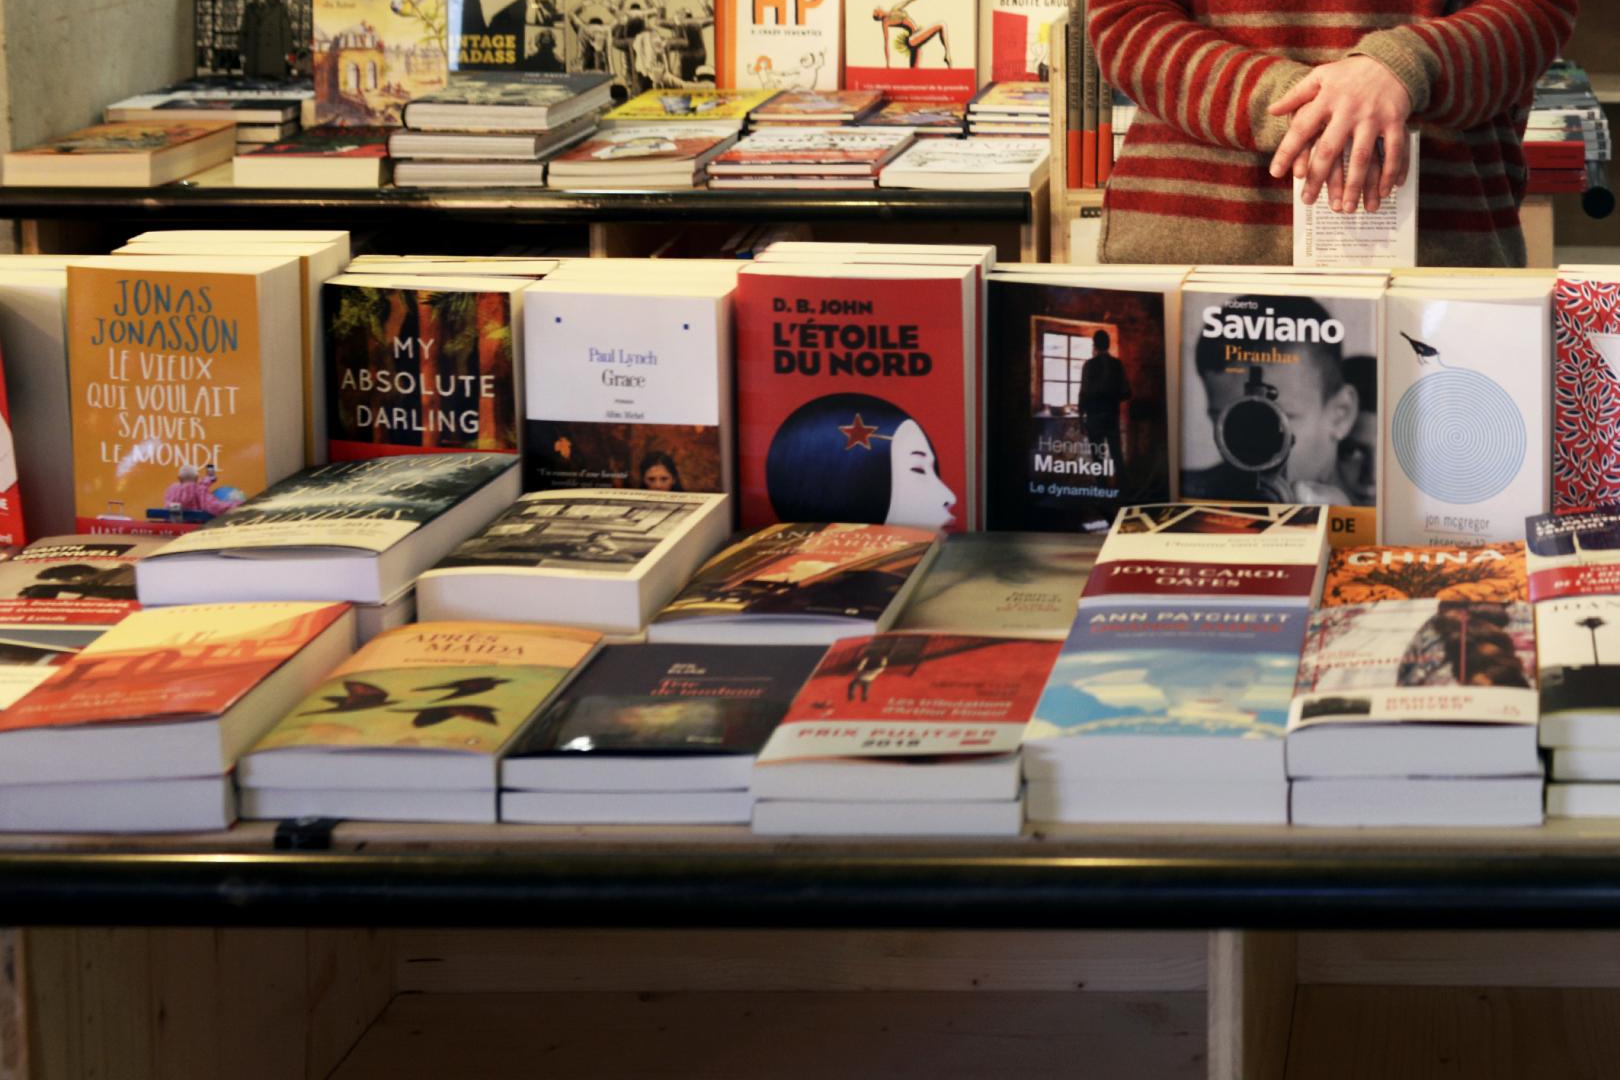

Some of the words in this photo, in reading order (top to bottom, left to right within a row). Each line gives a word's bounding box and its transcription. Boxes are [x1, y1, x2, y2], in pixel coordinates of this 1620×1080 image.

[459, 33, 516, 49] NTAGE
[458, 49, 516, 64] ADASS
[113, 279, 214, 317] JONAS
[773, 297, 791, 312] D.
[796, 298, 816, 313] B.
[819, 299, 873, 316] JOHN
[90, 314, 238, 354] JONASSON
[773, 318, 920, 350] L'ÉTOILE
[1202, 305, 1346, 345] Saviano
[393, 336, 435, 360] MY
[588, 347, 615, 364] Paul
[619, 349, 657, 368] Lynch
[108, 347, 130, 381] LE
[139, 351, 214, 381] VIEUX
[773, 350, 822, 376] DU
[829, 350, 933, 377] NORD
[340, 368, 496, 398] ABSOLUTE
[601, 369, 646, 388] Grace
[85, 382, 130, 410] QUI
[134, 384, 240, 417] VOULAIT
[117, 411, 207, 441] SAUVER
[356, 405, 480, 434] DARLING
[100, 441, 123, 464] LE
[133, 442, 223, 471] MONDE
[1037, 435, 1111, 459] Henning
[1034, 454, 1115, 477] Mankell
[1029, 481, 1045, 494] Le
[1047, 483, 1120, 499] dynamiteur
[1331, 517, 1356, 533] DE
[1424, 512, 1441, 528] jon
[1443, 514, 1491, 532] mcgregor
[1110, 565, 1187, 577] JOYCE
[1197, 567, 1292, 580] CAROL
[1155, 576, 1240, 588] OATES
[1089, 612, 1148, 624] ANN
[1156, 611, 1293, 624] PATCHETT
[797, 727, 859, 739] PRIX
[869, 727, 999, 740] PULITZER
